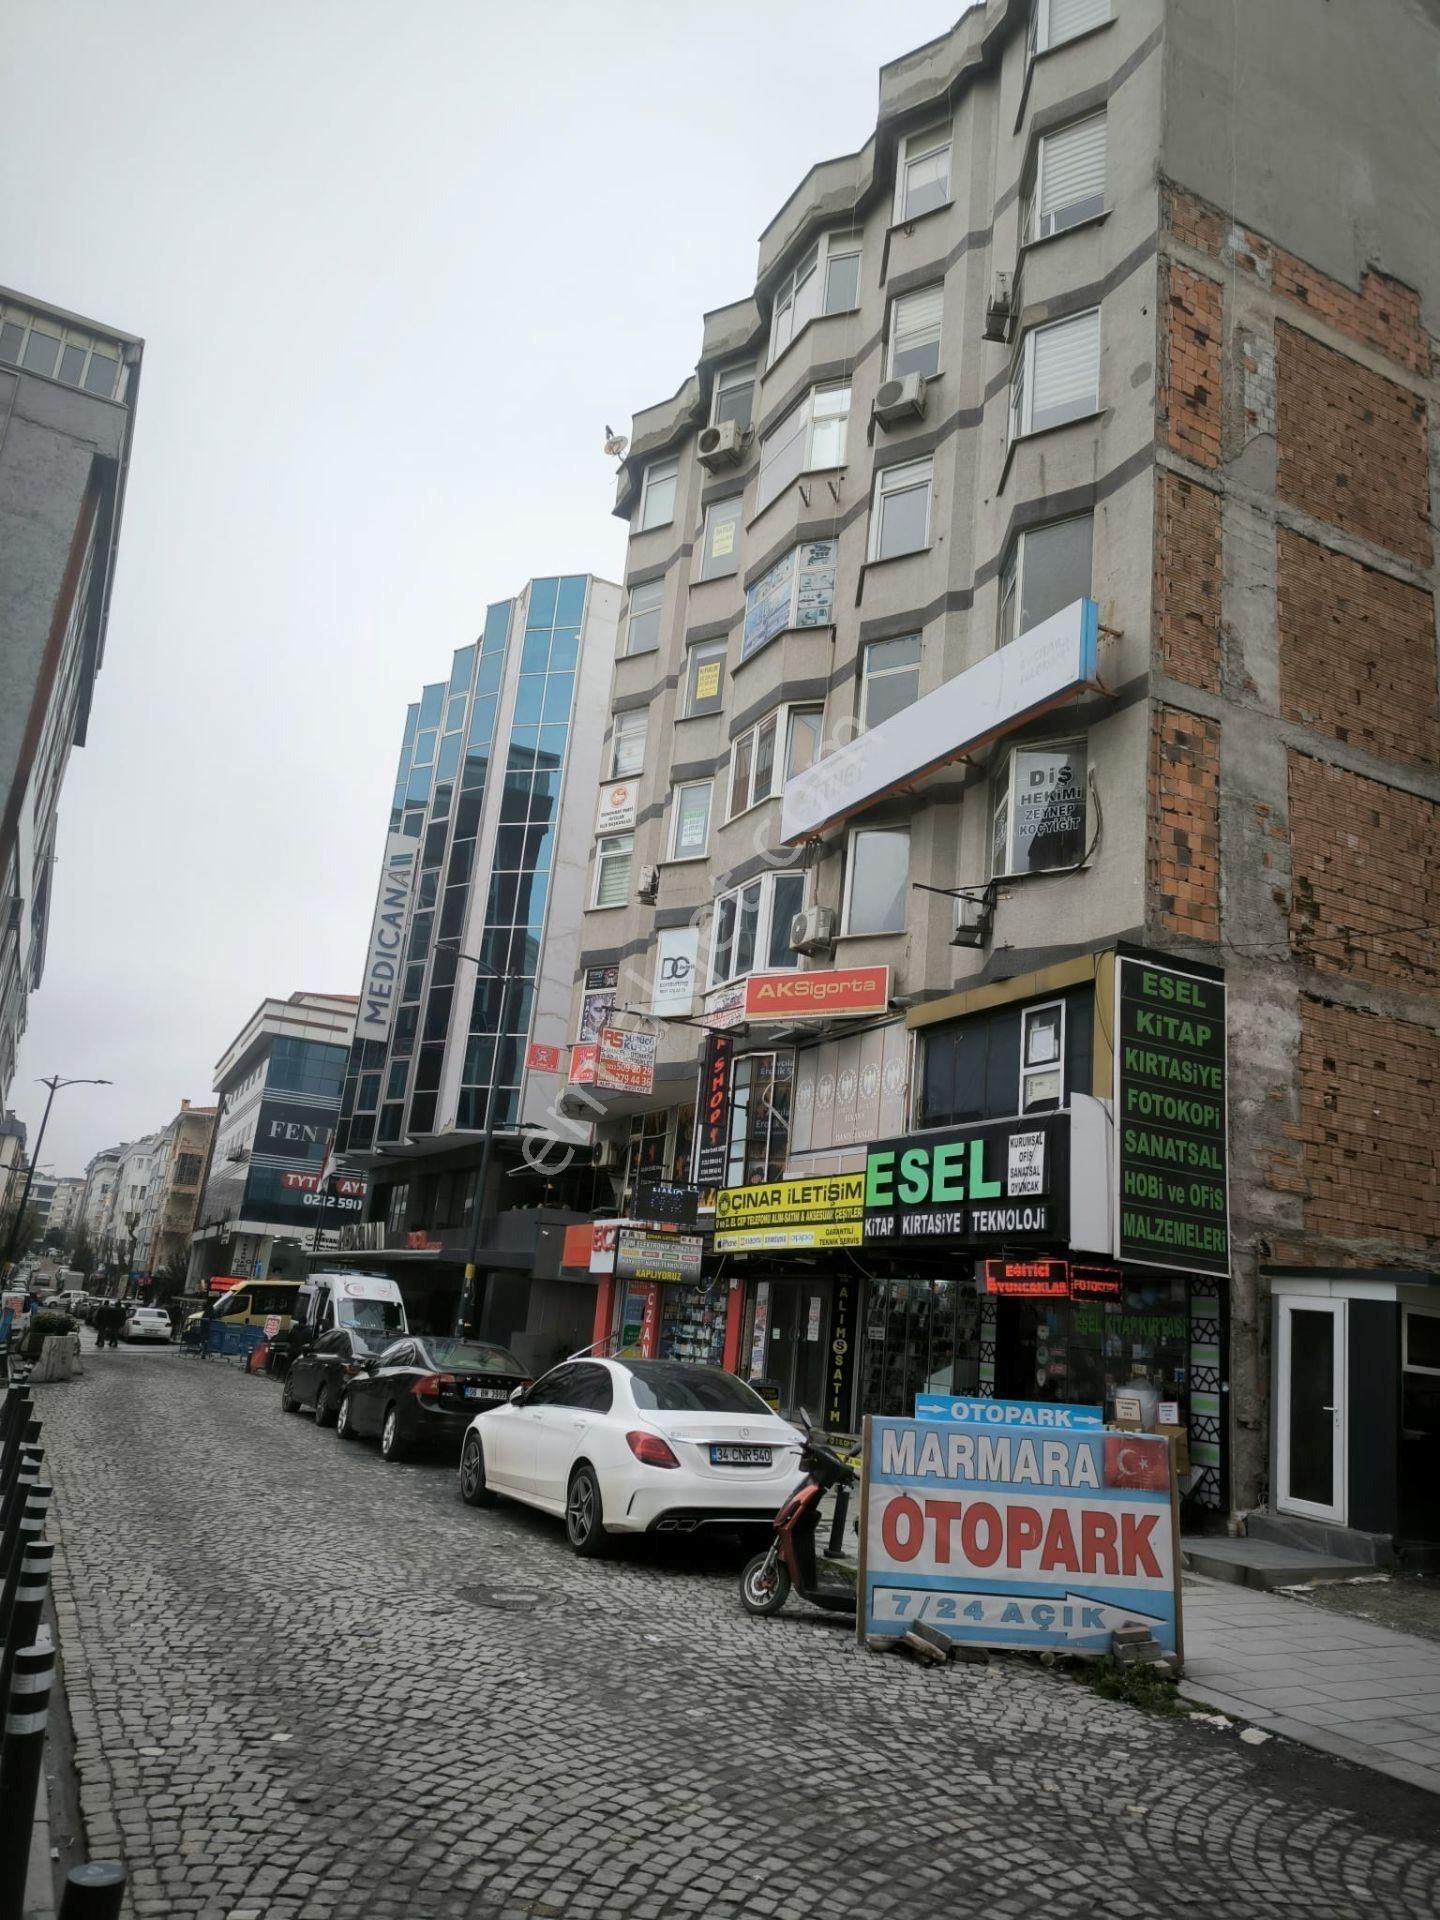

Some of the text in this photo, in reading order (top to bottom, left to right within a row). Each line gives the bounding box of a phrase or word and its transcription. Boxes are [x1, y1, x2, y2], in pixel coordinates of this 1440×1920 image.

[1025, 805, 1075, 820] ZEYNEP
[364, 870, 411, 1025] MEDICANA
[757, 979, 876, 1000] AKSigorta
[1142, 971, 1207, 1008] ESEL
[269, 1120, 318, 1142] FEN
[1010, 1134, 1043, 1148] KURUMSAL
[1125, 1129, 1223, 1171] SANATSAL
[287, 1173, 317, 1188] TYT
[865, 1139, 1001, 1208] ESEL
[1010, 1166, 1041, 1179] SANATSAL
[1010, 1180, 1039, 1194] OYUNCAK
[1167, 1184, 1185, 1204] ve
[731, 1190, 782, 1214] ÇINAR
[951, 1402, 1073, 1428] OTOPARK
[717, 1448, 770, 1462] 34 CNR 540
[881, 1428, 1100, 1490] MARMARA
[881, 1495, 1164, 1579] OTOPARK
[891, 1594, 1107, 1631] 7/24 AÇIK
